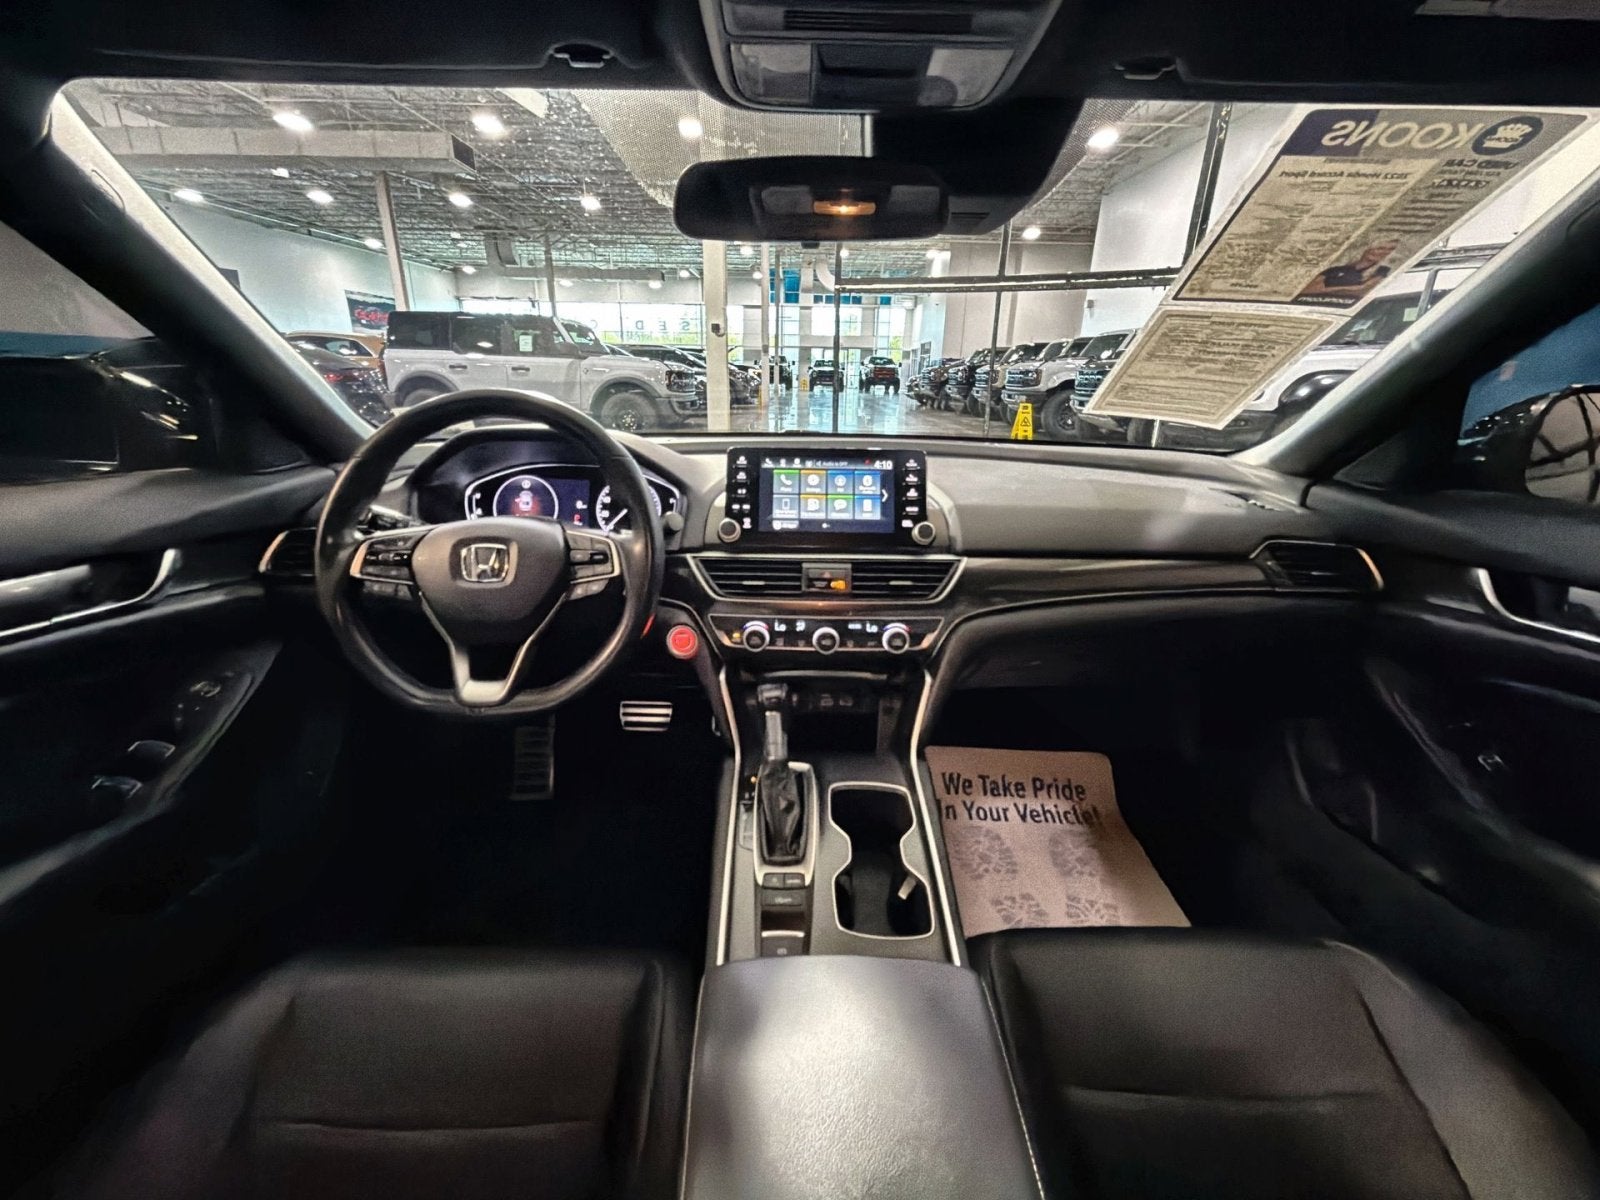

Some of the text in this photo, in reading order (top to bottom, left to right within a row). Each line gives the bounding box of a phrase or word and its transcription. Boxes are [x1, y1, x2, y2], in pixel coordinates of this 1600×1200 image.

[873, 460, 893, 470] 4:10
[941, 772, 1086, 802] We Take Pride
[962, 801, 1011, 823] Your
